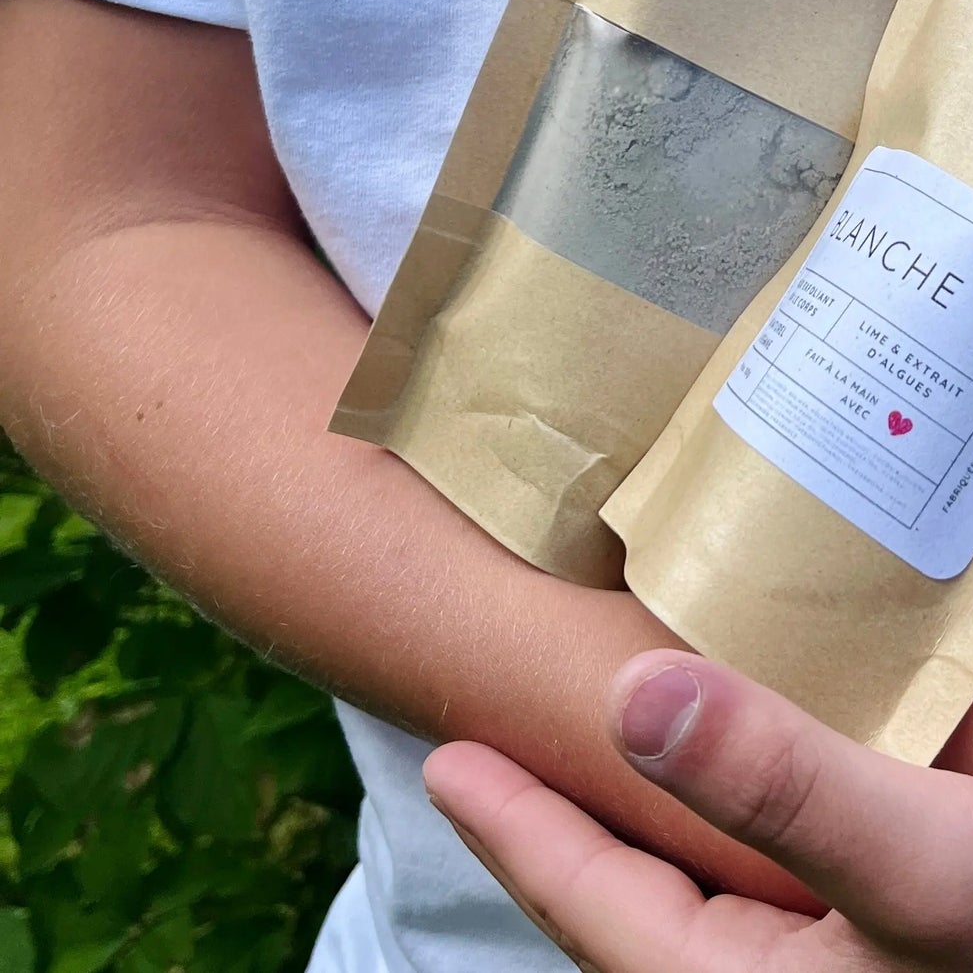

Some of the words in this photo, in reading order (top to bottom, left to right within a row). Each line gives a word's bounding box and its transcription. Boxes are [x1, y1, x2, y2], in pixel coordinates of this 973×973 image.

[830, 209, 965, 309] BLANCHE
[804, 348, 826, 366] FAIT
[825, 361, 834, 374] À
[834, 370, 848, 384] LA
[850, 381, 879, 406] MAIN
[858, 320, 889, 346] LIME
[890, 344, 901, 355] &
[904, 353, 964, 398] EXTRAIT
[867, 347, 933, 399] D'ALGUES
[840, 395, 871, 421] AVEC
